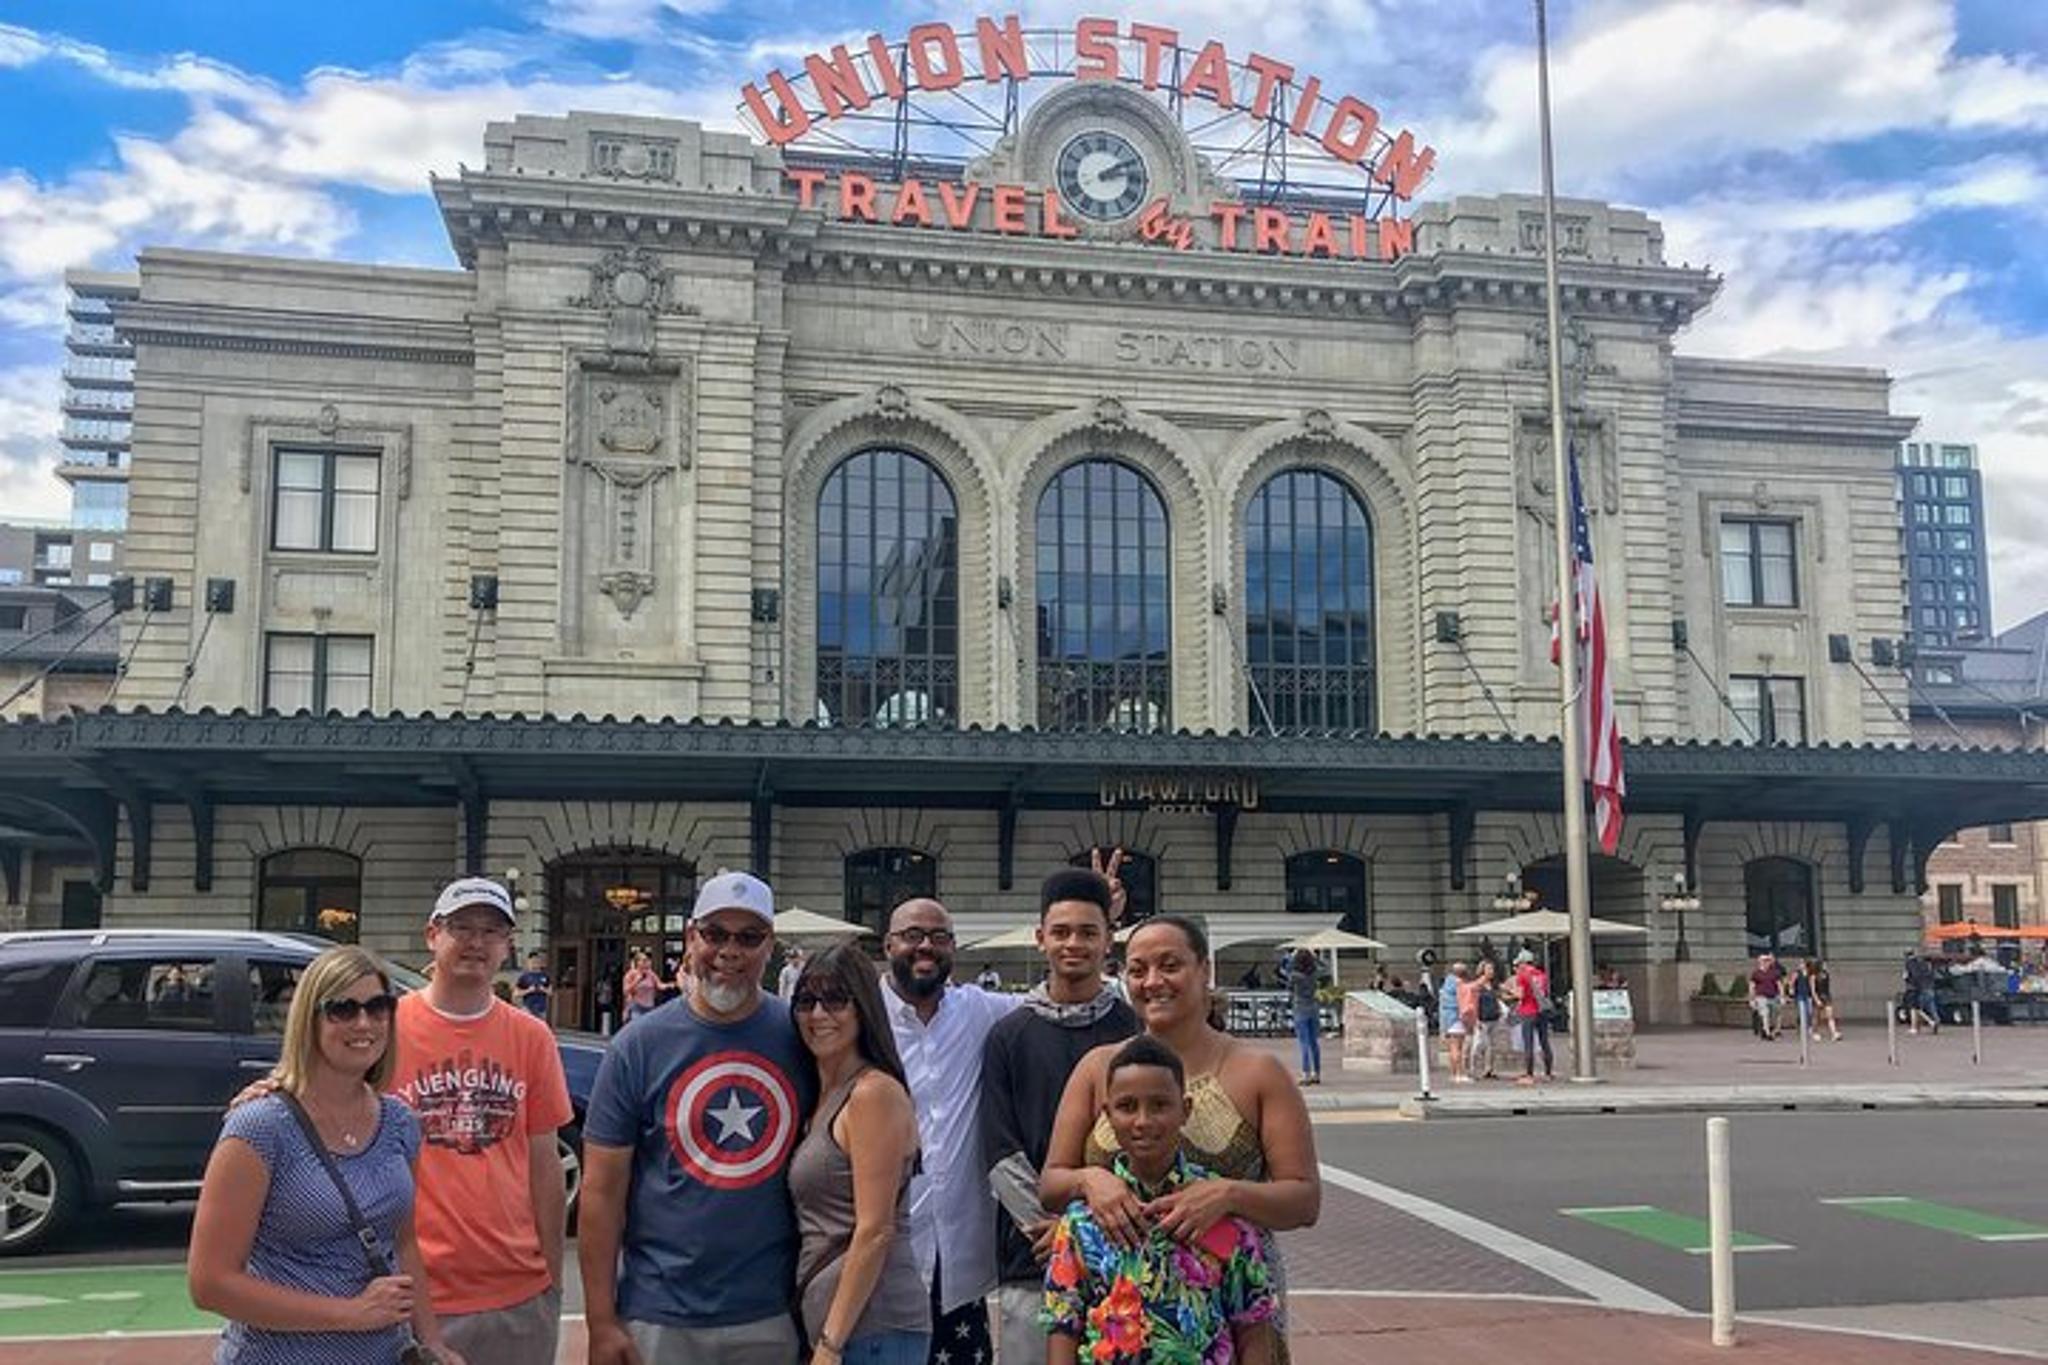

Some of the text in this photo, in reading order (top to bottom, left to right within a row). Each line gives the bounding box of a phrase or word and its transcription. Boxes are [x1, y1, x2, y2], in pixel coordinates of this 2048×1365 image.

[741, 15, 1437, 201] UNION STATION
[785, 169, 1413, 261] TRAVEL by TRAIN
[909, 316, 1298, 371] UNION STATION
[398, 1068, 527, 1103] YUENGLING
